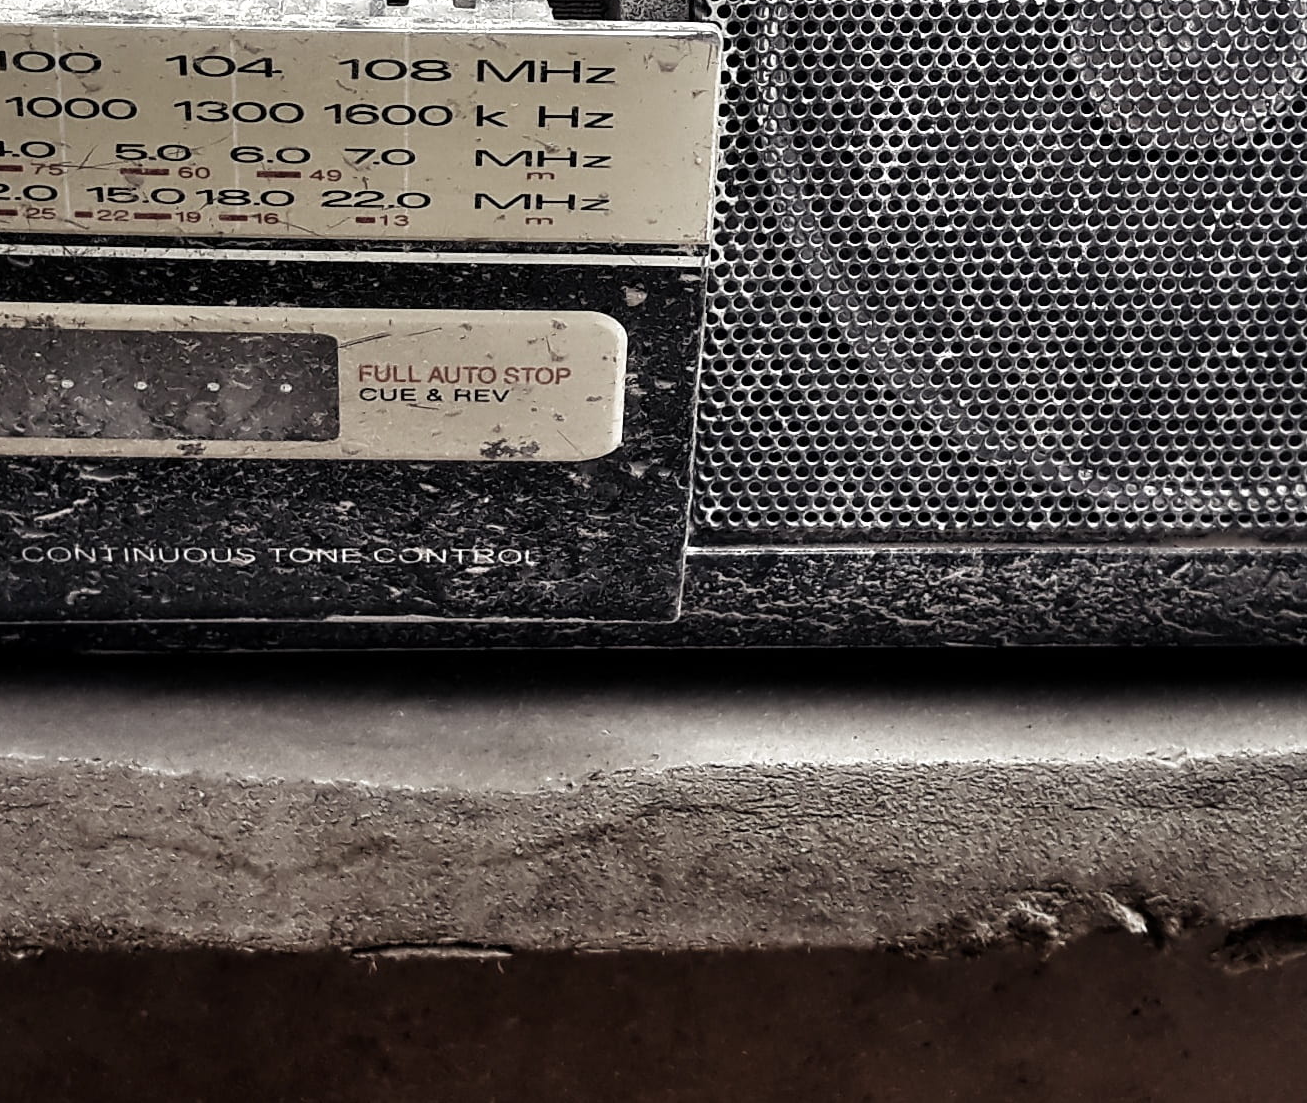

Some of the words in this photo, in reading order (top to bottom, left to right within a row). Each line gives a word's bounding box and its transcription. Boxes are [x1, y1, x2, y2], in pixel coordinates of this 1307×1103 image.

[164, 55, 283, 78] 104
[339, 59, 451, 82] 108
[476, 61, 617, 85] MHz
[5, 97, 138, 121] 1000
[173, 101, 304, 124] 1300
[324, 104, 453, 127] 1600
[115, 144, 192, 162] 5.0
[230, 146, 311, 164] 6.0
[343, 148, 416, 166] 7.0
[475, 149, 612, 168] MHz
[30, 163, 64, 176] 75
[177, 166, 210, 179] 60
[309, 169, 342, 182] 49
[526, 171, 555, 180] m
[87, 186, 186, 204] 15.0
[197, 189, 295, 206] 18.0
[321, 190, 431, 208] 22.0
[474, 193, 610, 211] MHz
[25, 207, 56, 219] 25
[97, 209, 129, 222] 22
[175, 210, 202, 224] 19
[249, 213, 280, 225] 16
[380, 214, 409, 227] 13
[525, 217, 554, 225] m
[359, 364, 422, 383] FULL
[428, 366, 497, 384] AUTO
[503, 366, 572, 385] STOP
[359, 388, 417, 401] CUE
[426, 388, 443, 402] &
[454, 388, 510, 403] REV
[22, 546, 256, 564] CONTINUOUS
[269, 548, 361, 564] TONE
[373, 547, 538, 566] CONTROL
